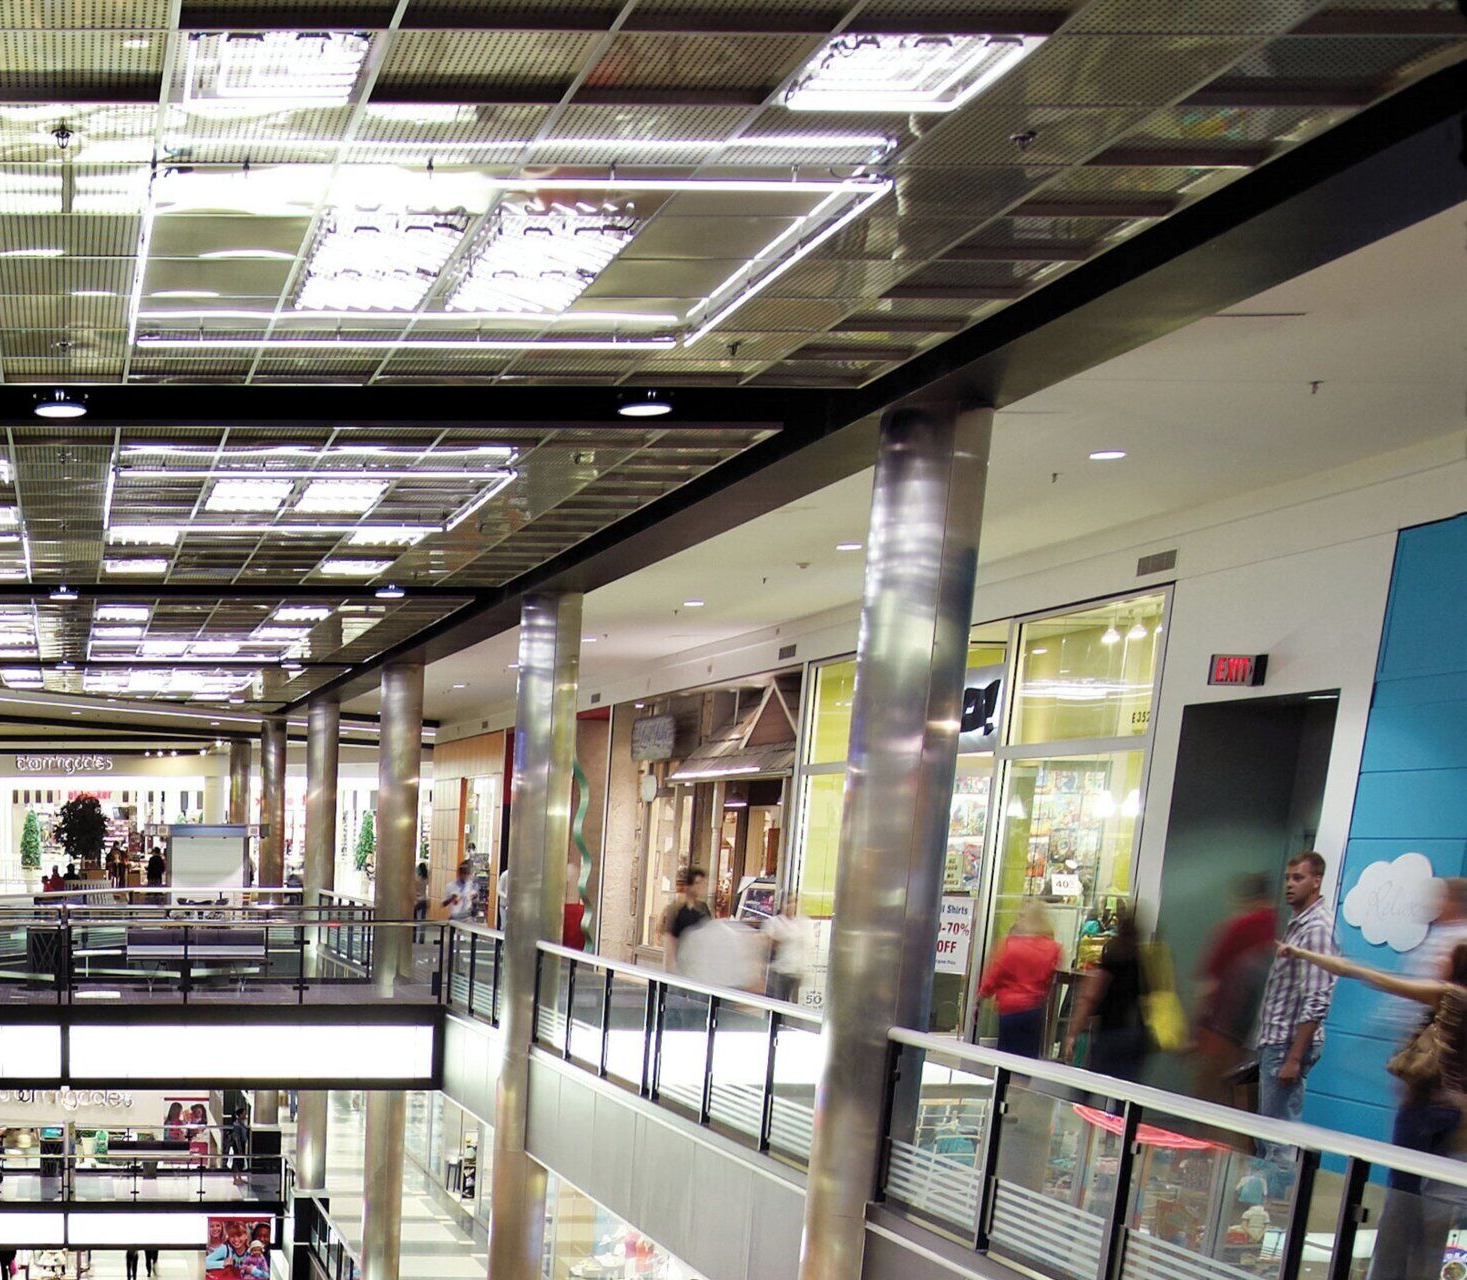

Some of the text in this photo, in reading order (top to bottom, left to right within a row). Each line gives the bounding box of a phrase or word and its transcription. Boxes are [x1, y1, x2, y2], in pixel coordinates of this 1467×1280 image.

[1214, 656, 1250, 683] EXIT
[946, 904, 968, 915] Shirts
[937, 921, 970, 937] -70%
[936, 940, 958, 954] OFF
